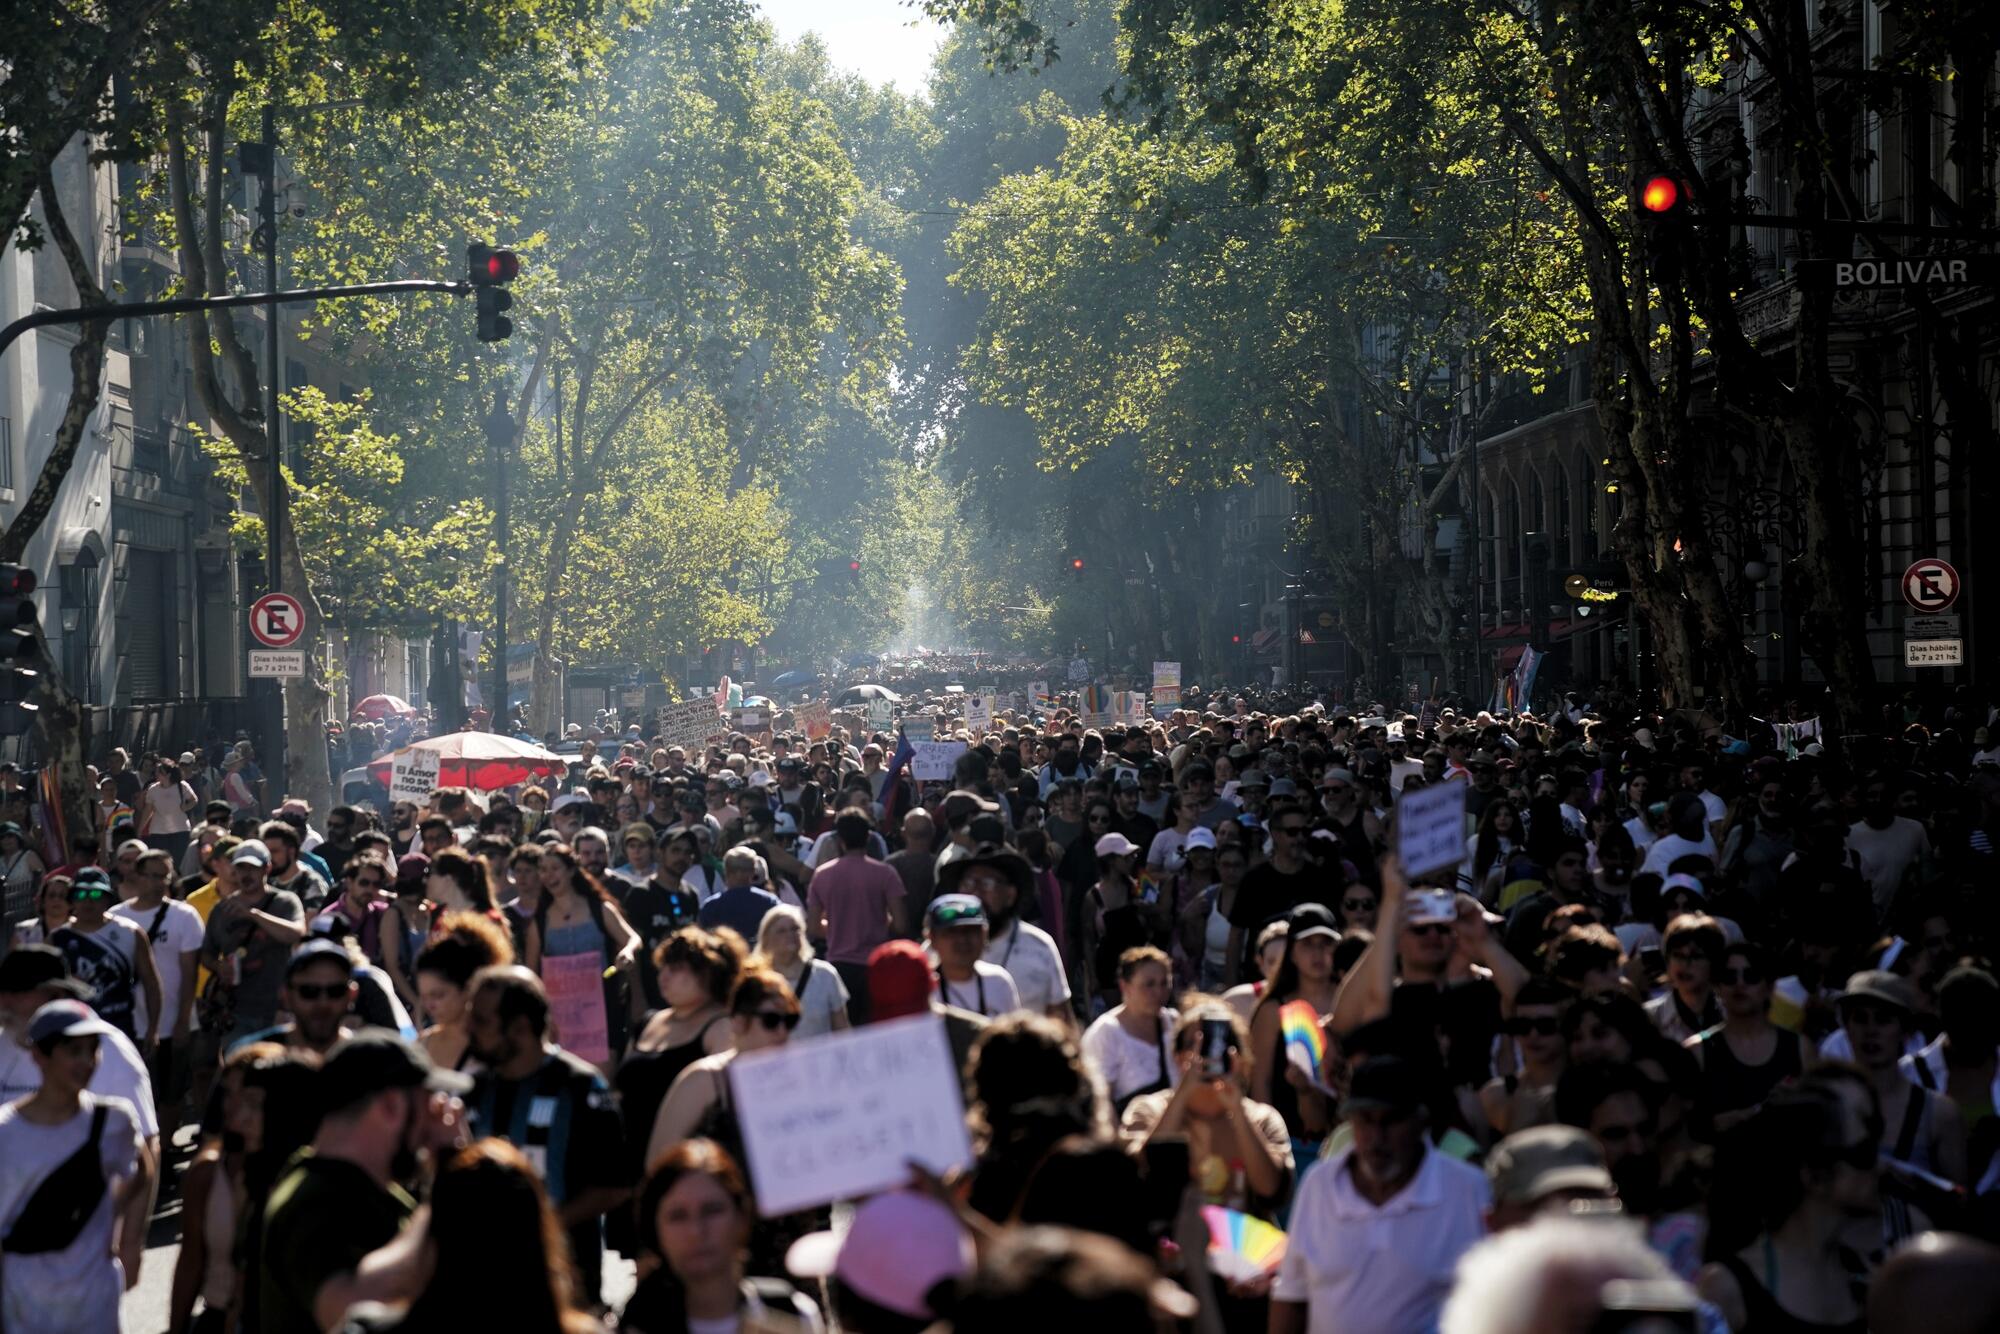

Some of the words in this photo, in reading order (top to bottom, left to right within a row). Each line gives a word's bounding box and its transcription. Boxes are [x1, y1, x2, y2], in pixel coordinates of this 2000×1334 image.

[1836, 260, 1967, 285] BOLIVAR
[870, 699, 892, 713] NO
[397, 765, 406, 774] El
[408, 767, 437, 778] Amor
[417, 778, 430, 786] se
